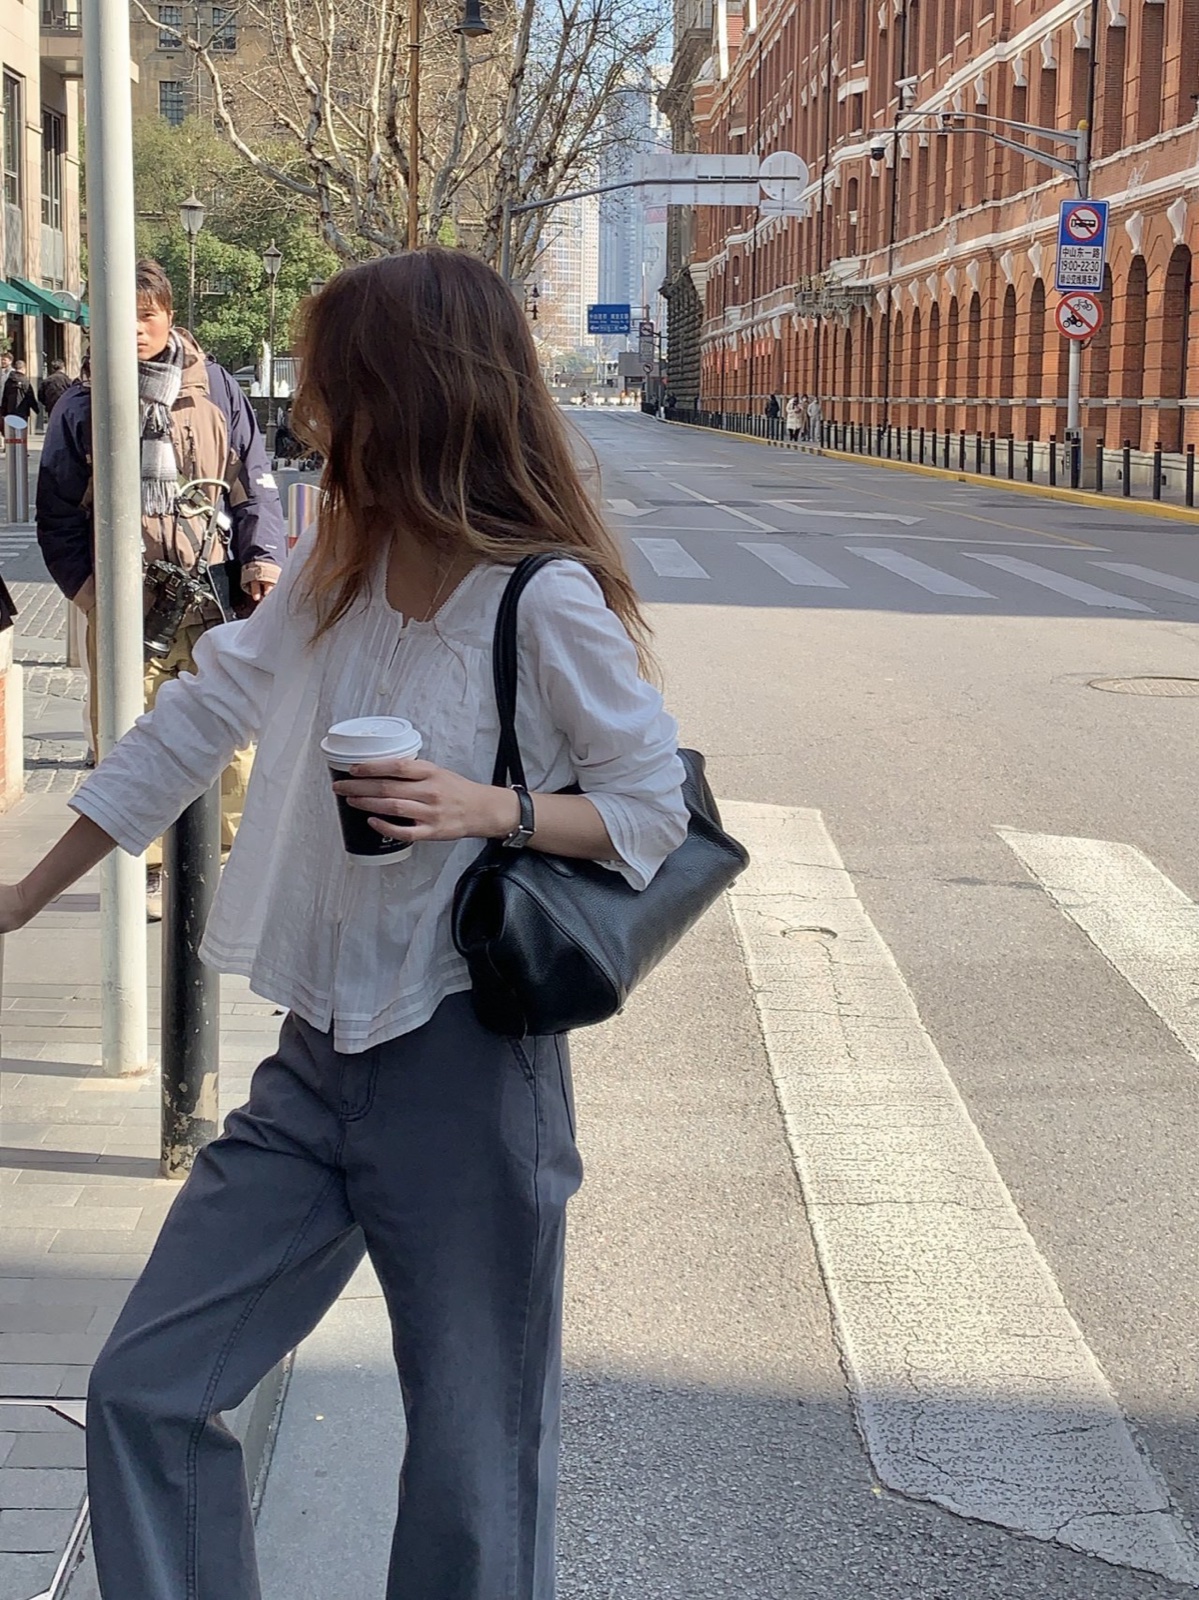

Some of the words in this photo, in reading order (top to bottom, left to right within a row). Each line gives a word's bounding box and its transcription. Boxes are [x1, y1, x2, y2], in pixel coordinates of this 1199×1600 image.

[1062, 247, 1100, 258] 中山东一路
[1061, 260, 1100, 272] 19:00-22:30
